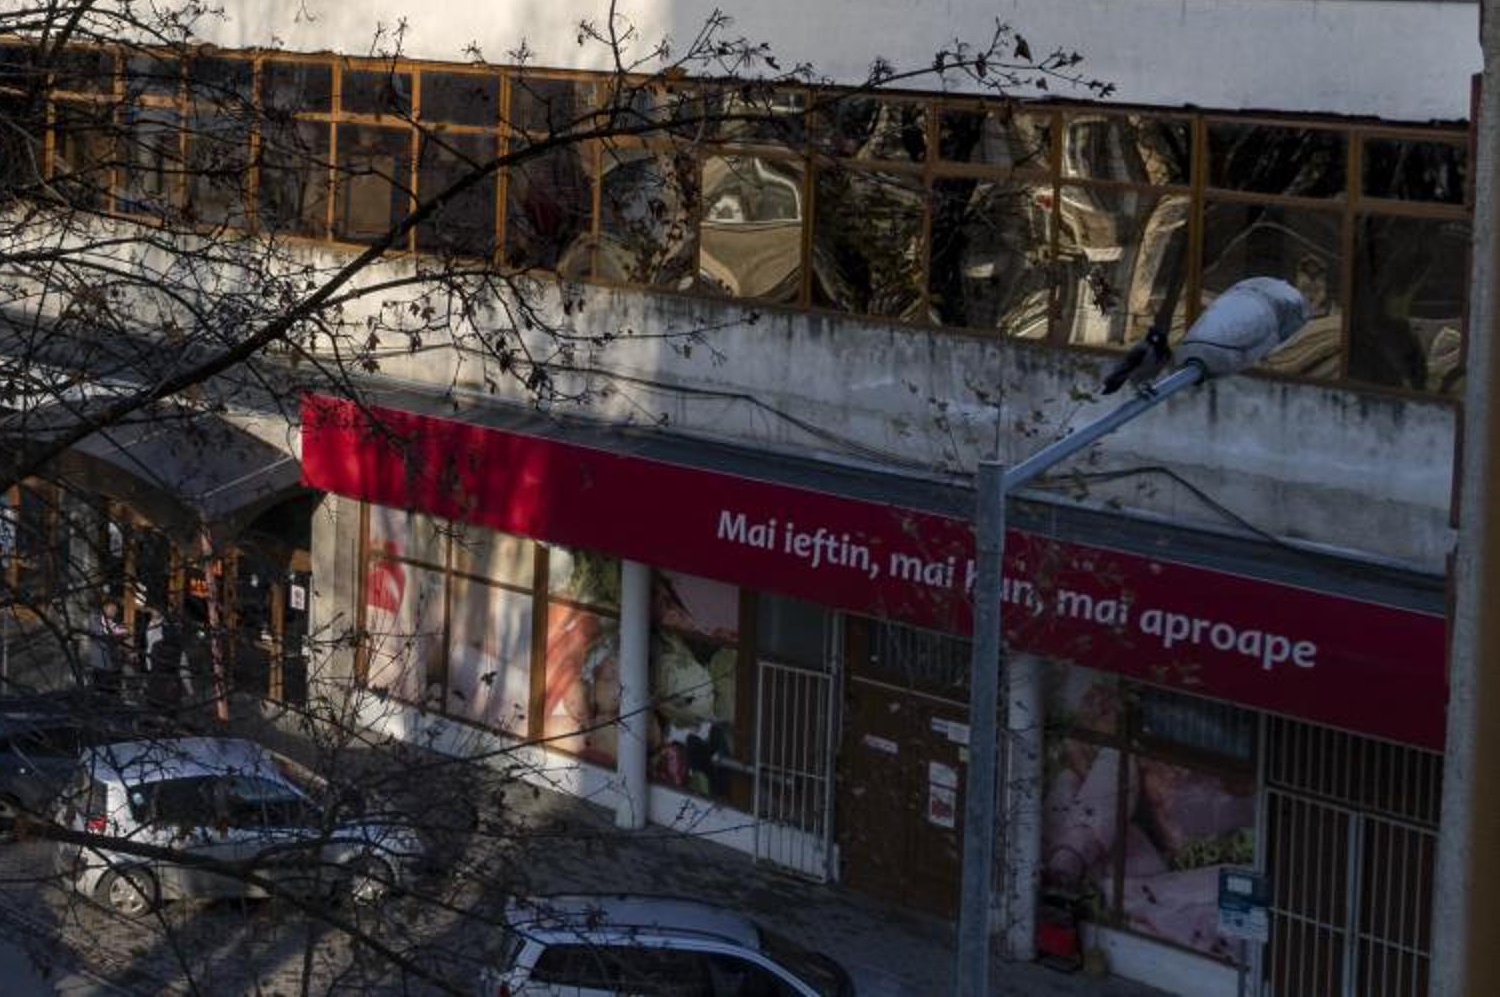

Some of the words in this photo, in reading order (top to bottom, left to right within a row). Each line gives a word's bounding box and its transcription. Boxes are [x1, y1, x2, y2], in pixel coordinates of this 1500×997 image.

[716, 509, 776, 550] Mai
[784, 522, 880, 579] ieftin,
[889, 552, 956, 588] mai
[1056, 588, 1129, 625] mai
[1139, 607, 1318, 670] aproape
